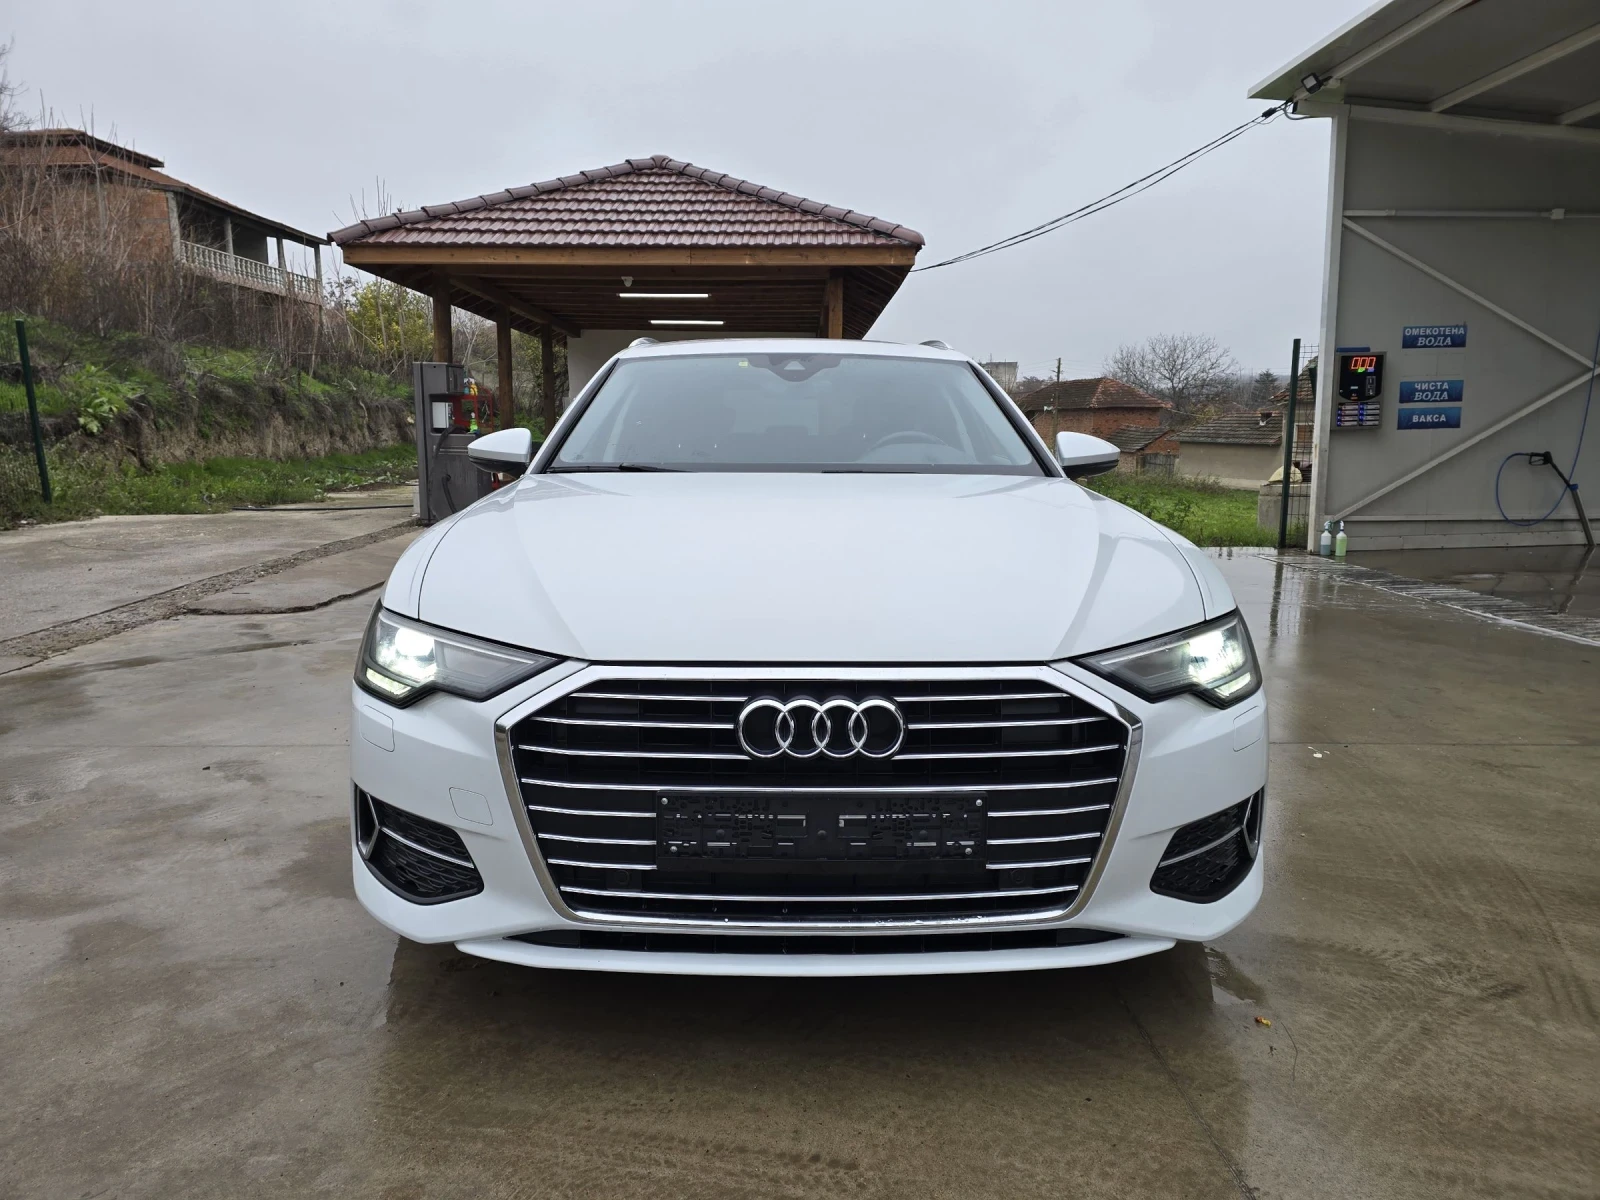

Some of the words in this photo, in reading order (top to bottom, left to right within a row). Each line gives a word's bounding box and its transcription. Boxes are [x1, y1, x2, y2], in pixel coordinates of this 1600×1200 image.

[1404, 327, 1465, 336] ОМЕКОТЕНА
[1417, 337, 1452, 346] ВОДА
[1414, 382, 1449, 390] ЧИСТА
[1413, 391, 1449, 401] ВОДА
[1412, 414, 1447, 423] ВАКСА
